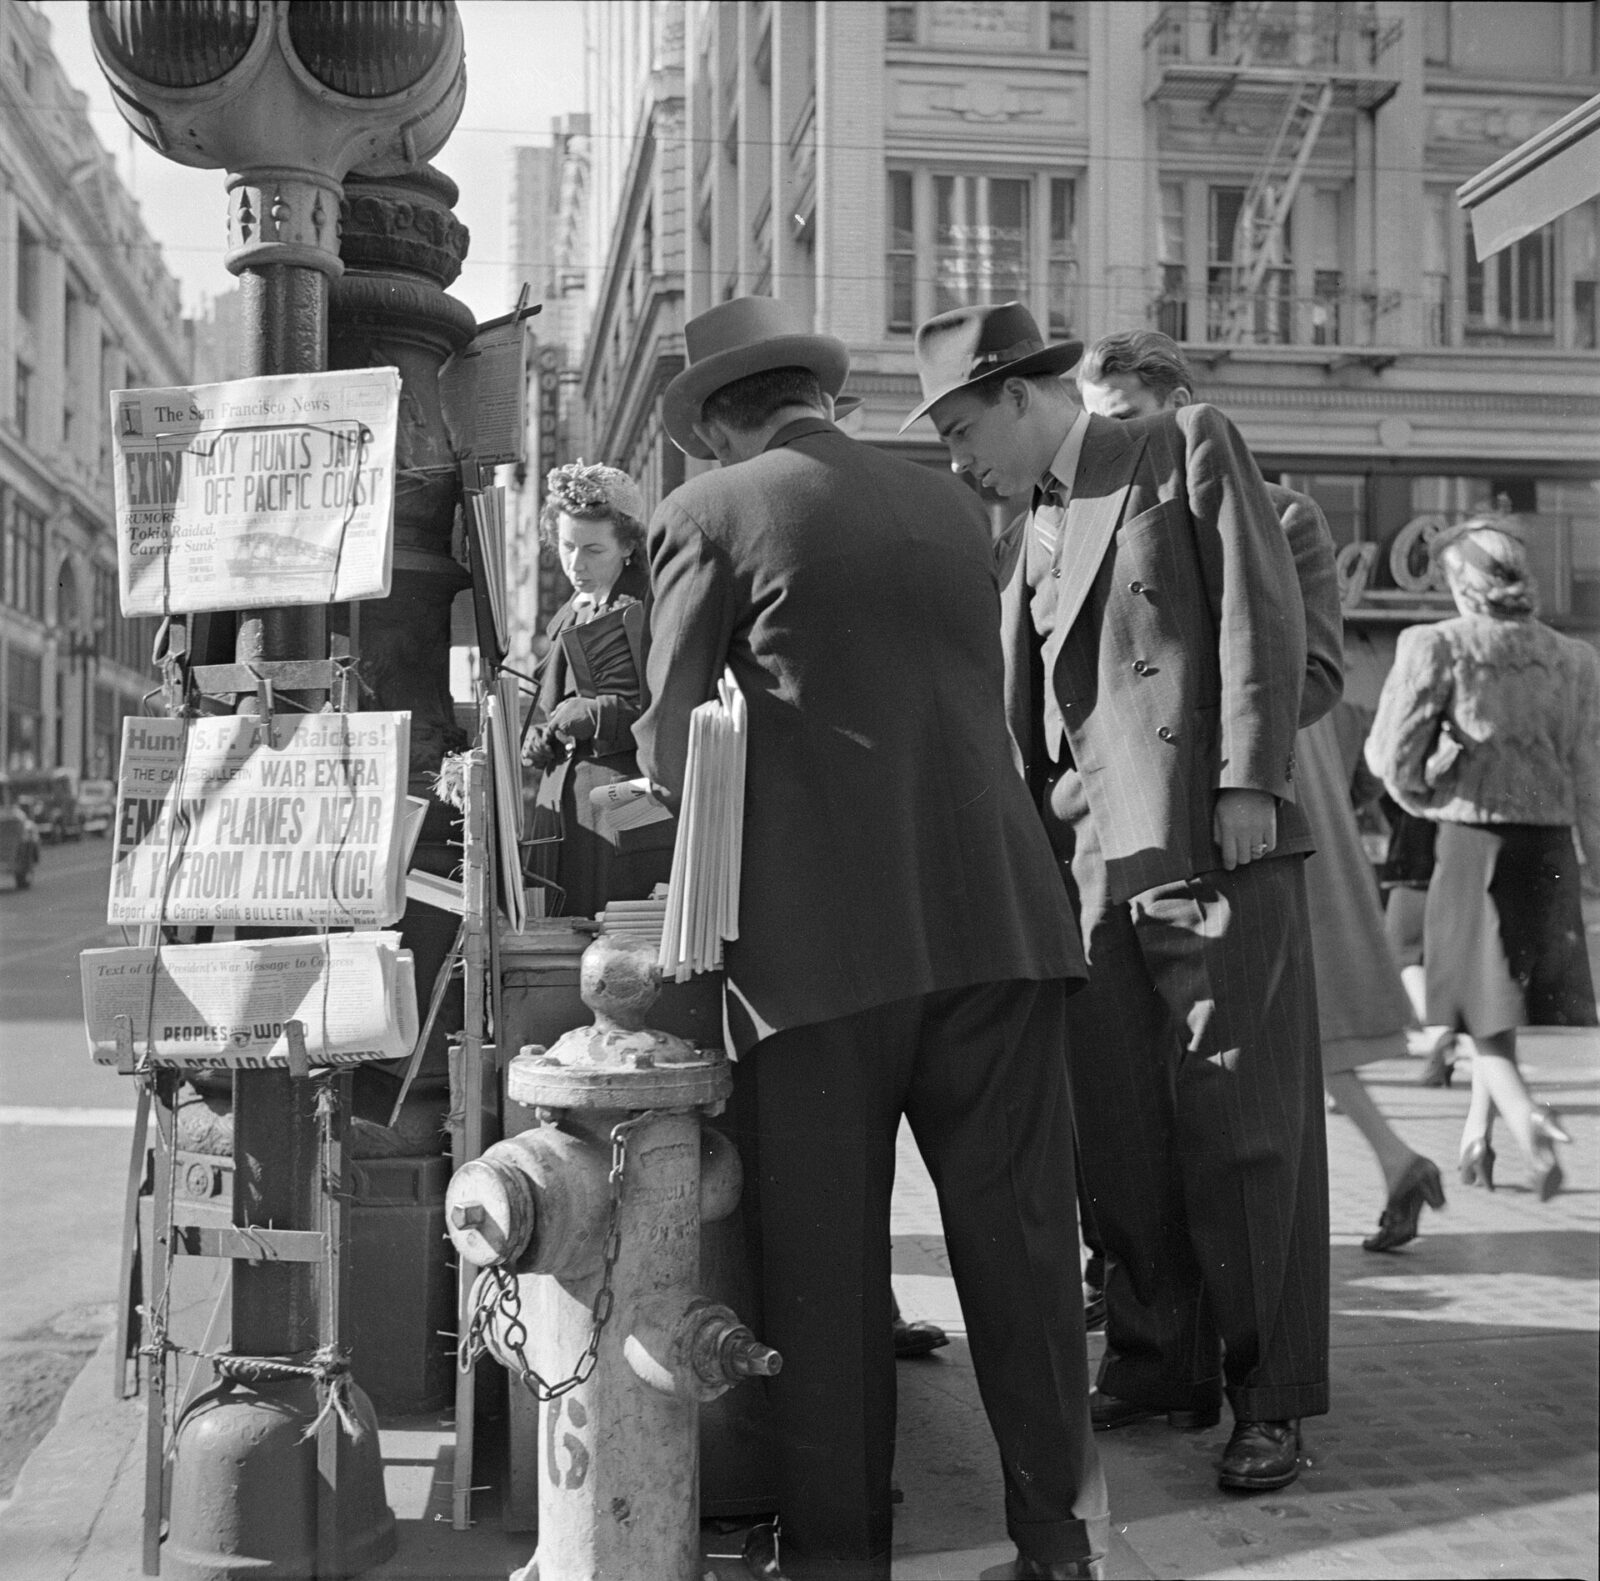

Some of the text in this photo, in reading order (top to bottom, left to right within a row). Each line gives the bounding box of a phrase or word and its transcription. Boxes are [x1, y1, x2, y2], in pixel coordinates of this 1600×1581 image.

[154, 397, 330, 422] The San Francisco News
[251, 432, 311, 472] HUNTS
[125, 450, 185, 505] EXTRA
[204, 476, 235, 516] OFF
[243, 470, 312, 513] PACIFIC
[129, 541, 180, 556] Carrier
[195, 730, 212, 750] S.
[218, 727, 236, 750] F.
[294, 724, 387, 748] Raiders!
[133, 768, 154, 780] THE
[261, 759, 379, 787] WAR EXTRA
[216, 797, 305, 846] PLANES
[316, 796, 382, 845] NEAR
[114, 851, 136, 899] N.
[173, 851, 243, 899] FROM
[252, 850, 376, 900] ATLANTIC!
[112, 903, 303, 921] Report Ja Carrier Sunk BULLETIN
[97, 964, 125, 976] Text
[129, 963, 141, 975] of
[219, 960, 240, 972] War
[244, 959, 290, 972] Message
[295, 958, 306, 968] to
[254, 1022, 308, 1041] WOD
